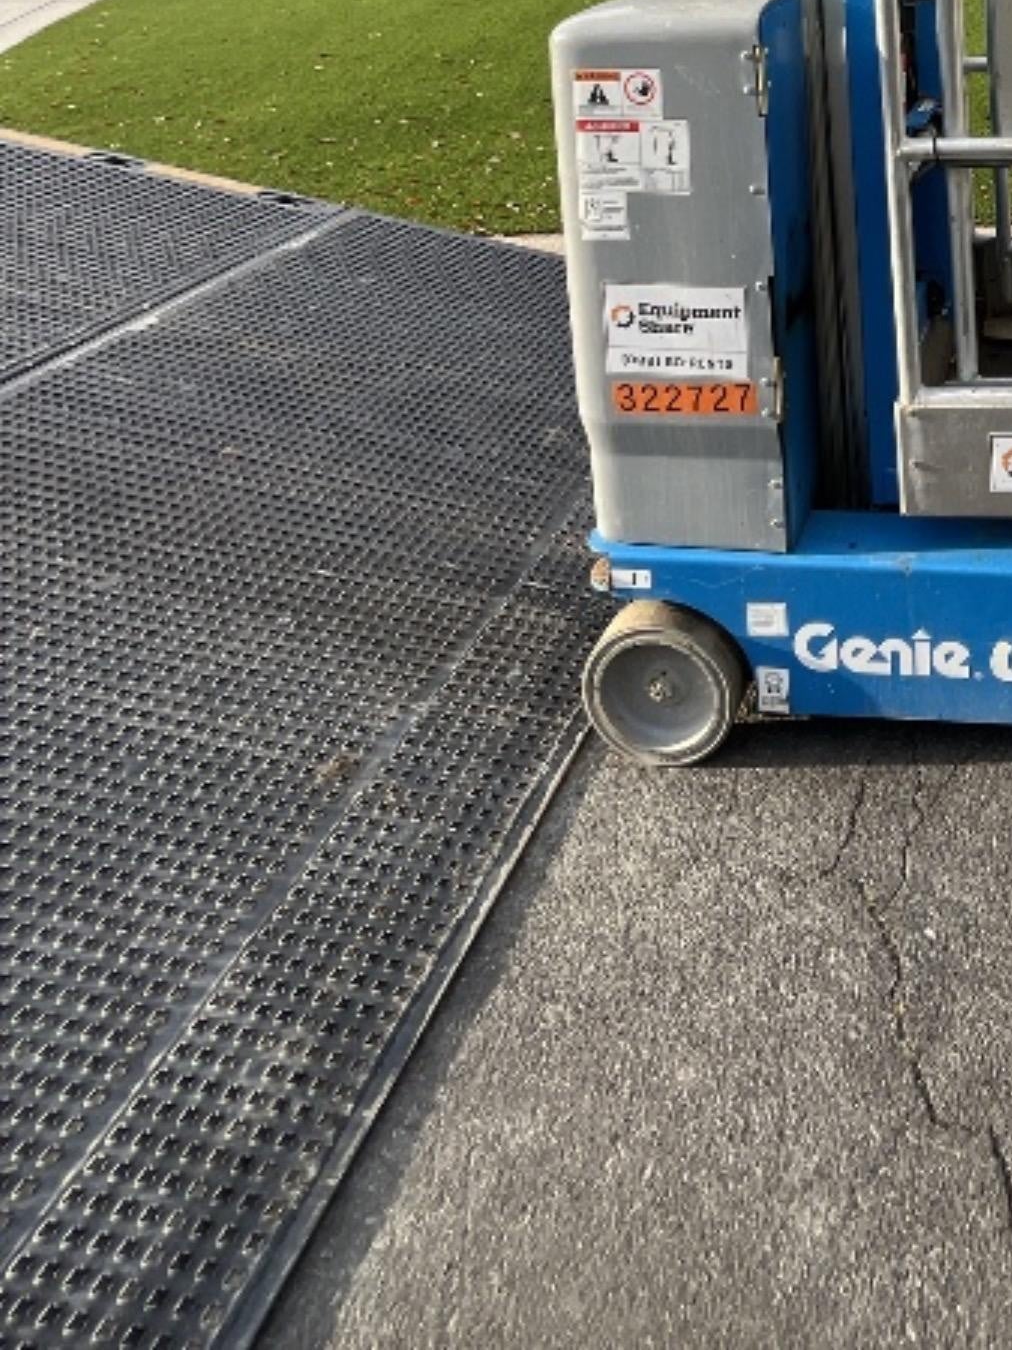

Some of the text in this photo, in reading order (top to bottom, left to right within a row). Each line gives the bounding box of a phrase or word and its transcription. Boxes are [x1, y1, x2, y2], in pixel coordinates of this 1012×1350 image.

[638, 302, 741, 321] Equipment
[616, 383, 750, 412] 322727
[793, 622, 970, 679] Genie
